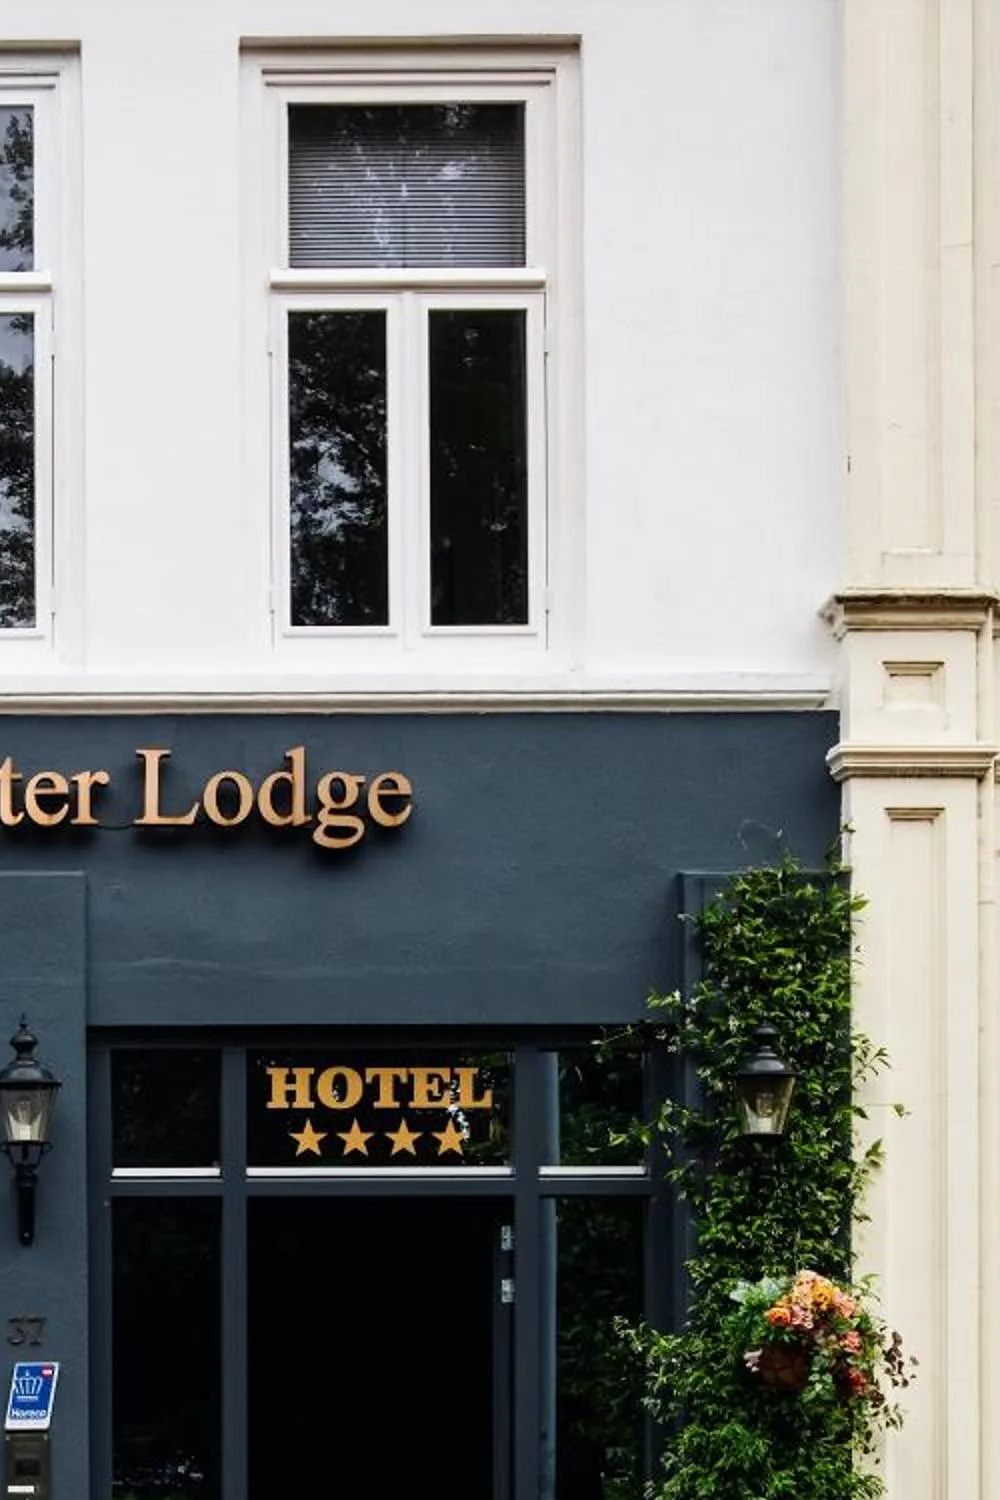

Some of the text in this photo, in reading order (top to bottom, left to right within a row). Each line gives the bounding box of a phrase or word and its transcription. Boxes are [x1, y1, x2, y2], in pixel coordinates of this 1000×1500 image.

[134, 745, 414, 850] Lodge
[265, 1065, 494, 1109] HOTEL
[6, 1317, 48, 1346] 37
